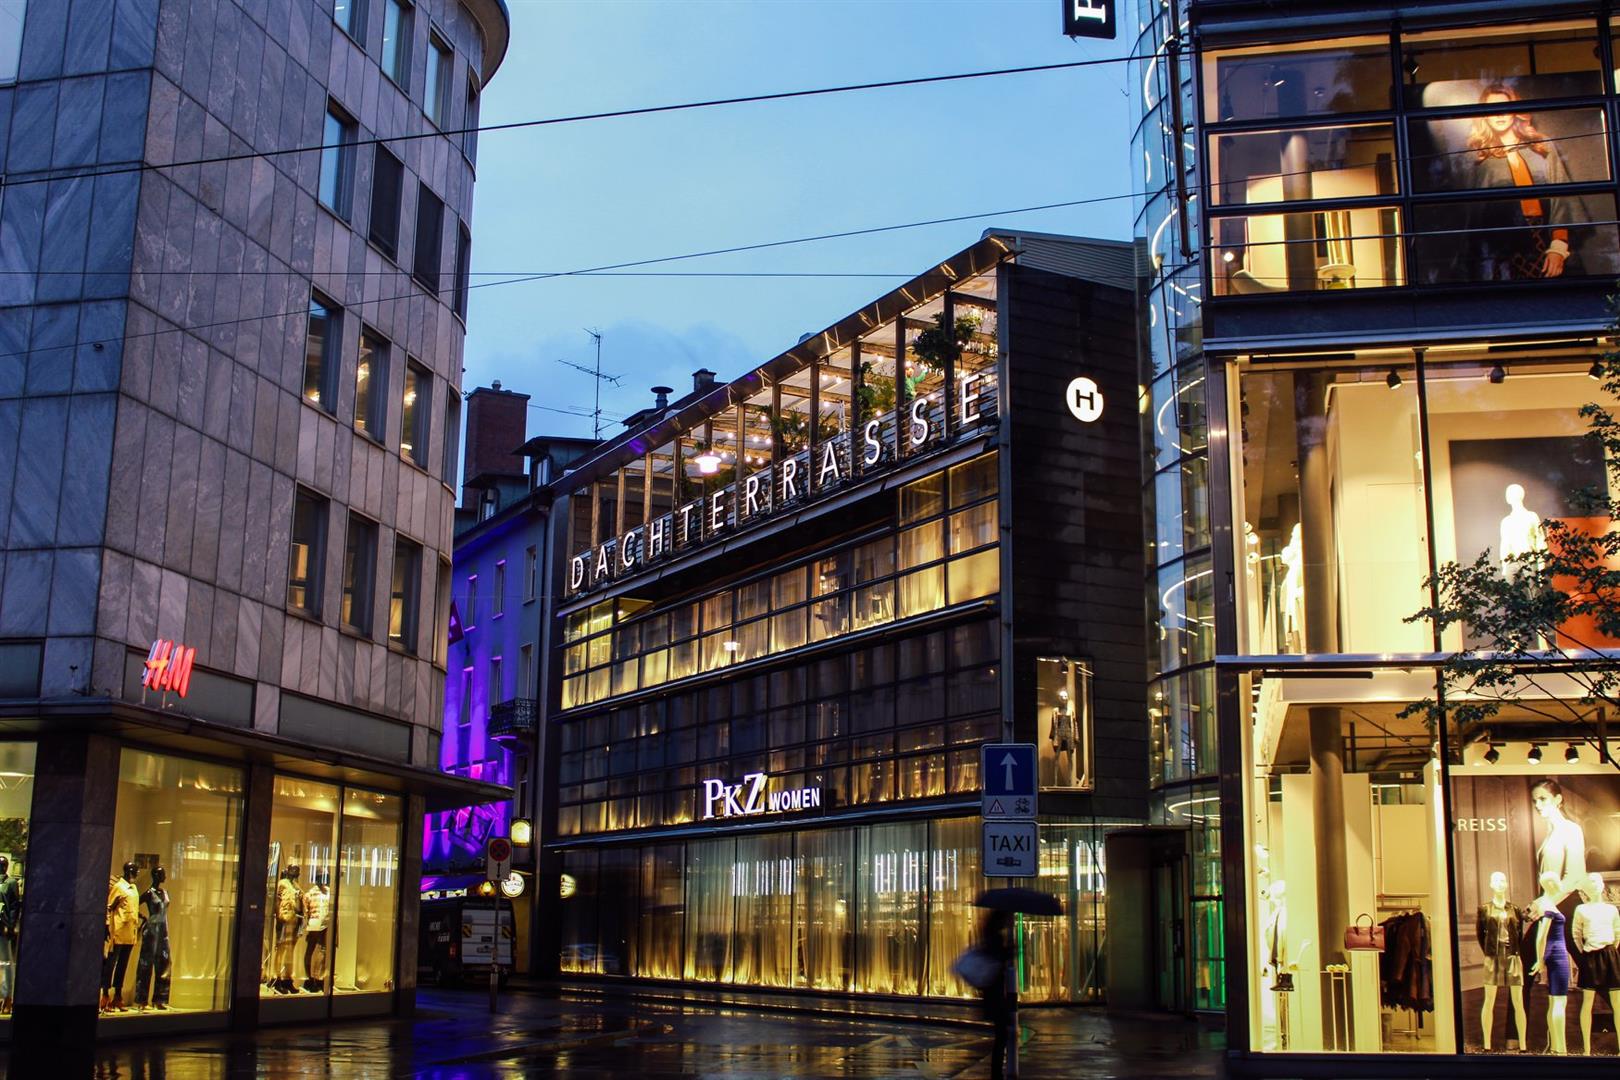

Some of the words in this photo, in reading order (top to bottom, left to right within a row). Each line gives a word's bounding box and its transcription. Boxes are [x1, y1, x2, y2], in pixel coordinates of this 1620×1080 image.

[1075, 389, 1095, 411] H
[571, 373, 981, 590] DACHTERRASSE
[143, 638, 197, 698] H&M
[769, 787, 820, 812] WOMEN
[1457, 818, 1507, 831] REISS
[989, 835, 1031, 852] TAXI
